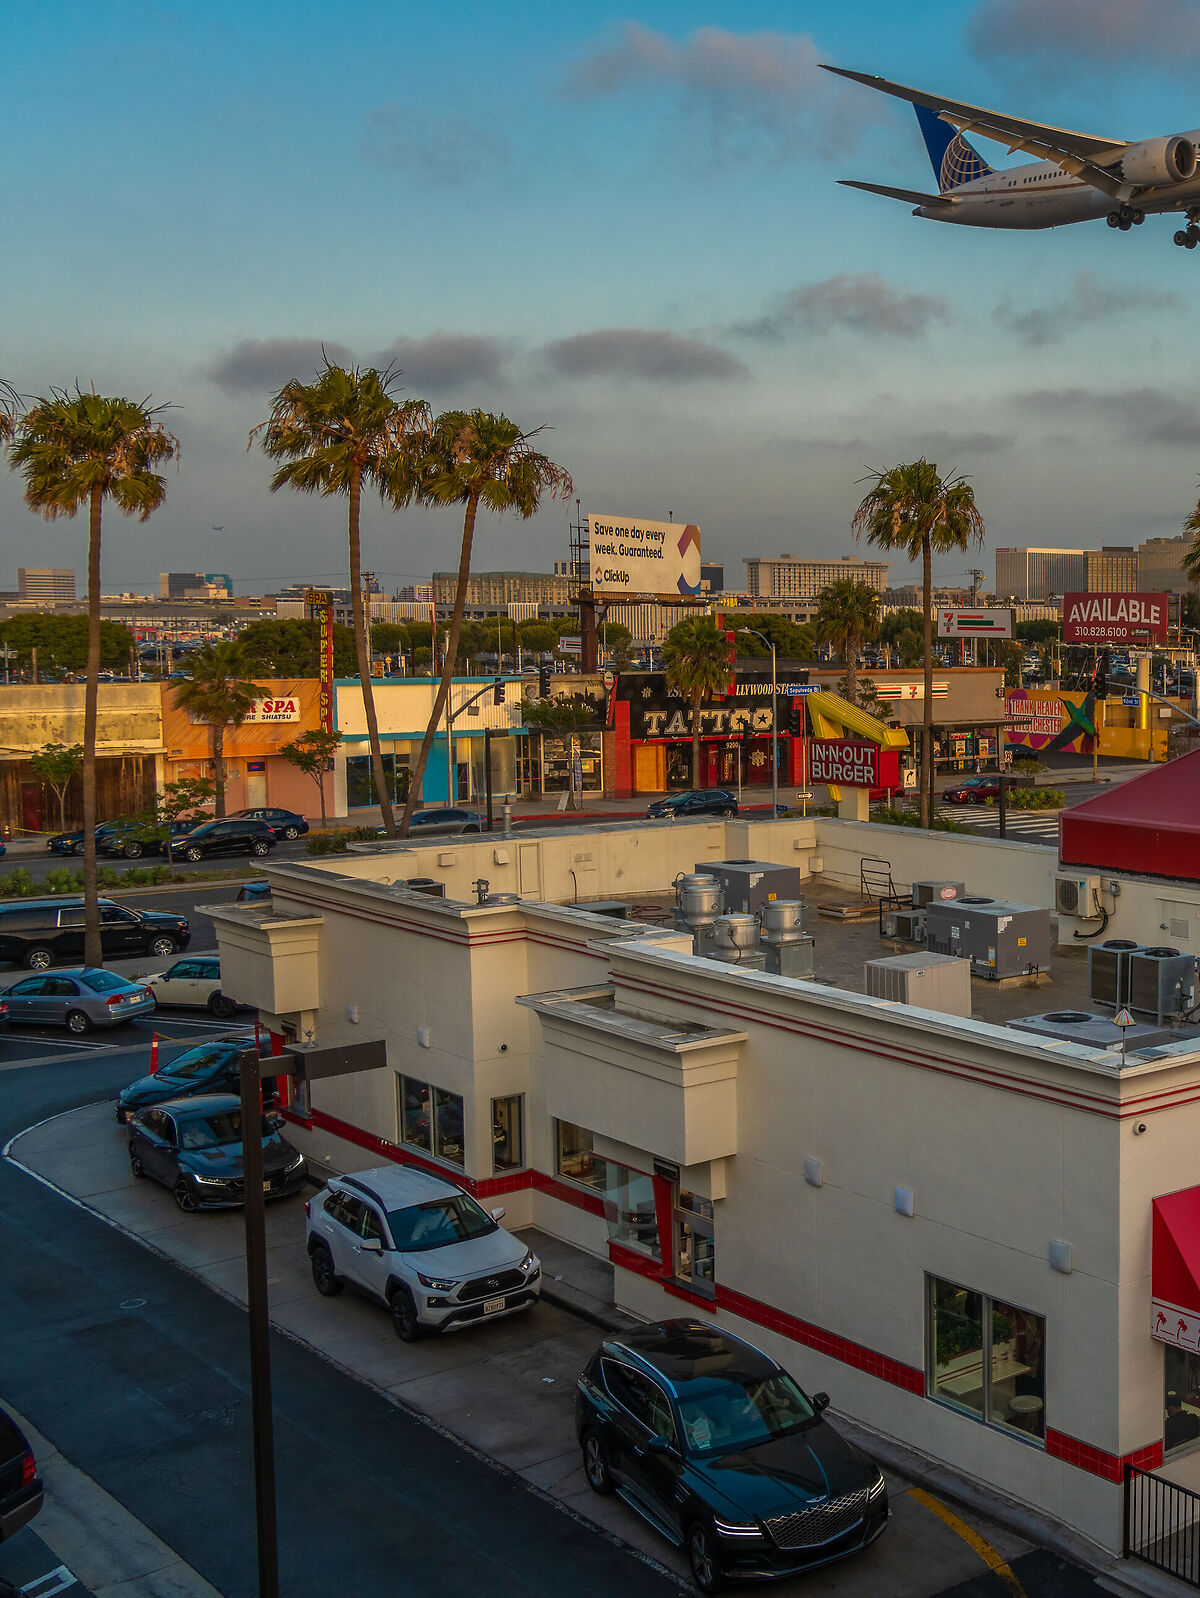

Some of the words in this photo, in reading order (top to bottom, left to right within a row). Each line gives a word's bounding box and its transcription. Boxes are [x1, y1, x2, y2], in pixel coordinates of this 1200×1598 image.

[594, 521, 614, 536] Save
[615, 526, 629, 538] one
[631, 526, 645, 543] day
[646, 530, 666, 545] every
[595, 543, 618, 555] week.
[619, 543, 664, 560] Guaranteed.
[604, 569, 630, 586] ClickUp
[308, 593, 327, 603] SPA
[1069, 598, 1161, 625] AVAILABLE
[1075, 626, 1128, 638] 310.828.6100
[320, 610, 328, 683] SUPER
[735, 683, 774, 696] LLYWOOD
[263, 700, 296, 713] SPA
[1011, 700, 1035, 715] THANK
[1036, 701, 1063, 717] HEAVEN
[644, 707, 775, 736] TATTOO
[725, 742, 739, 750] 9200
[811, 761, 875, 784] BURGER
